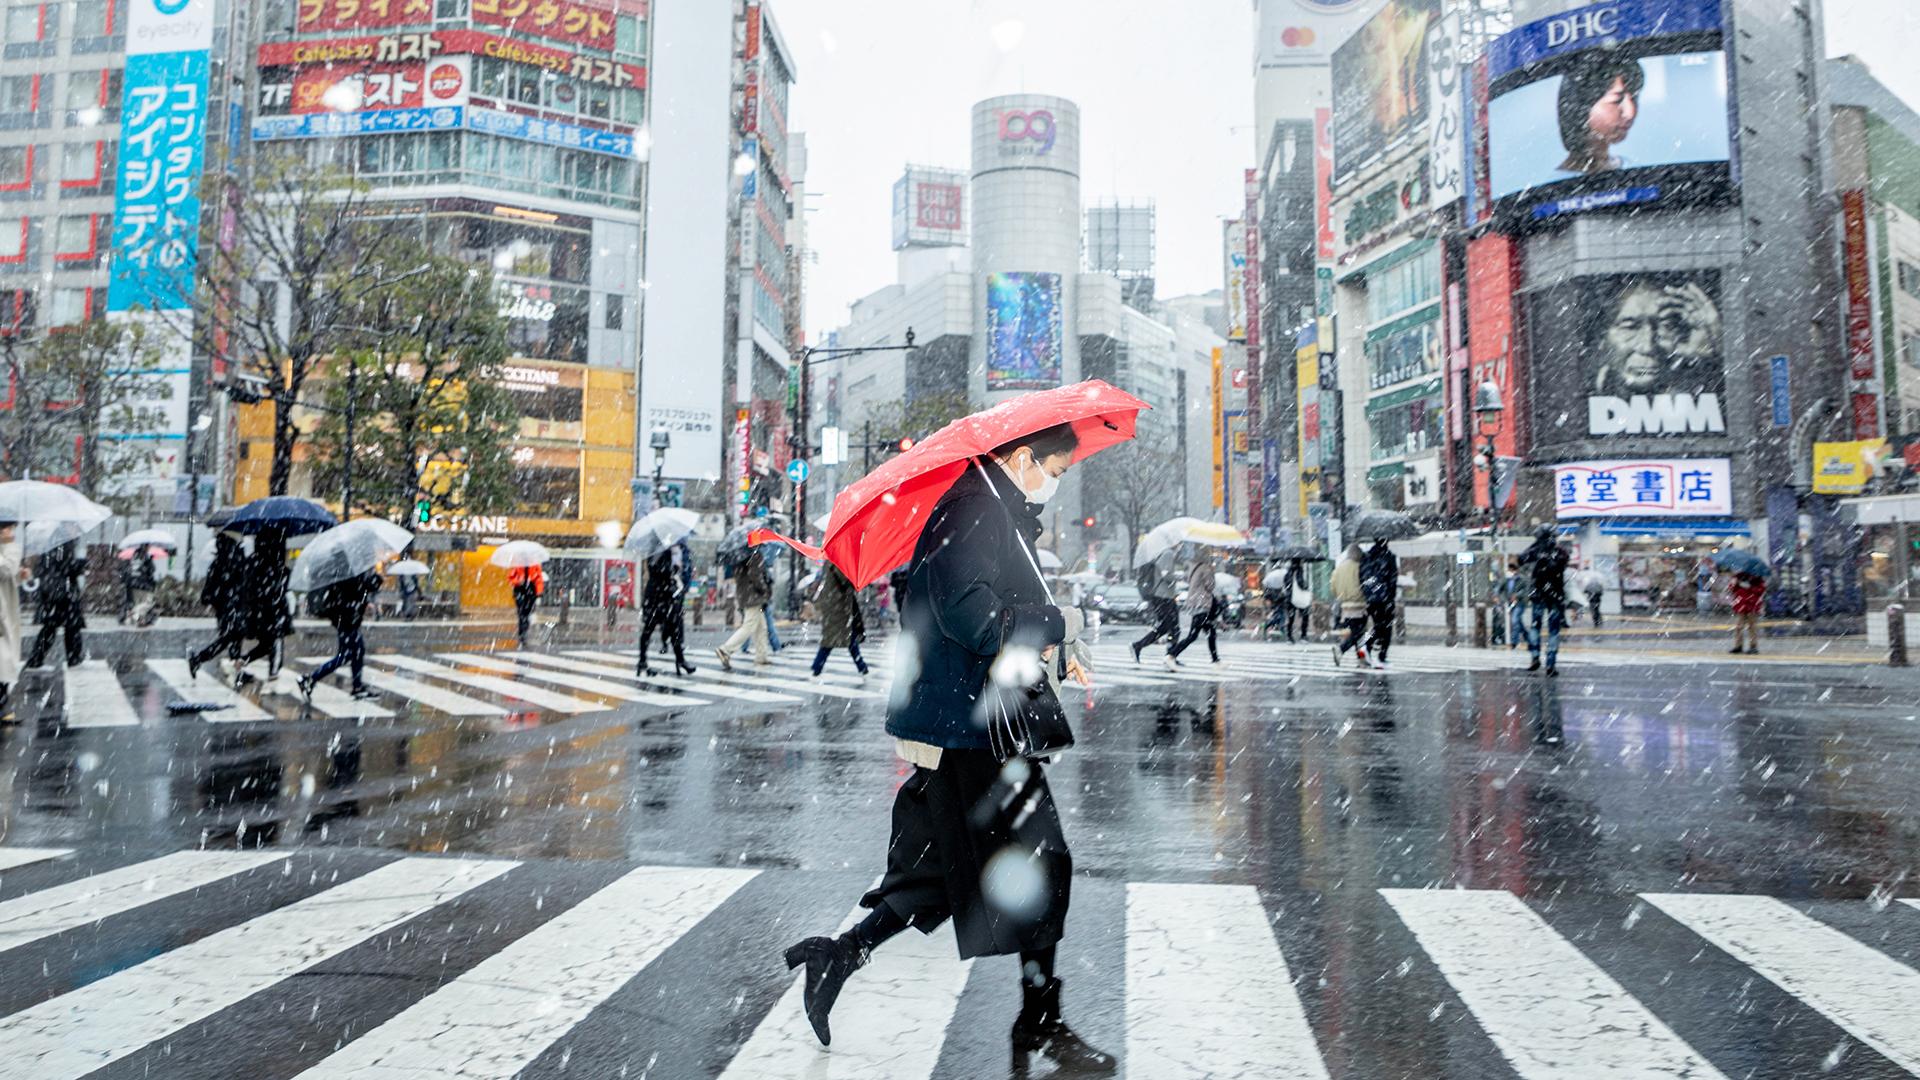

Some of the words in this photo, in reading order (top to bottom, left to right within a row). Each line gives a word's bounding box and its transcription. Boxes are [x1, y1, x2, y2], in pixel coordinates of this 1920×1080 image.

[137, 20, 202, 40] eyecity
[473, 0, 611, 39] コンタクト
[1547, 7, 1619, 48] DHC
[377, 35, 442, 62] ガスト
[571, 56, 633, 87] ガスト
[261, 84, 292, 105] 7F
[991, 109, 1056, 156] 109
[122, 86, 167, 268] アイシティ
[160, 83, 197, 267] コンタクトの
[1589, 393, 1725, 434] DMM
